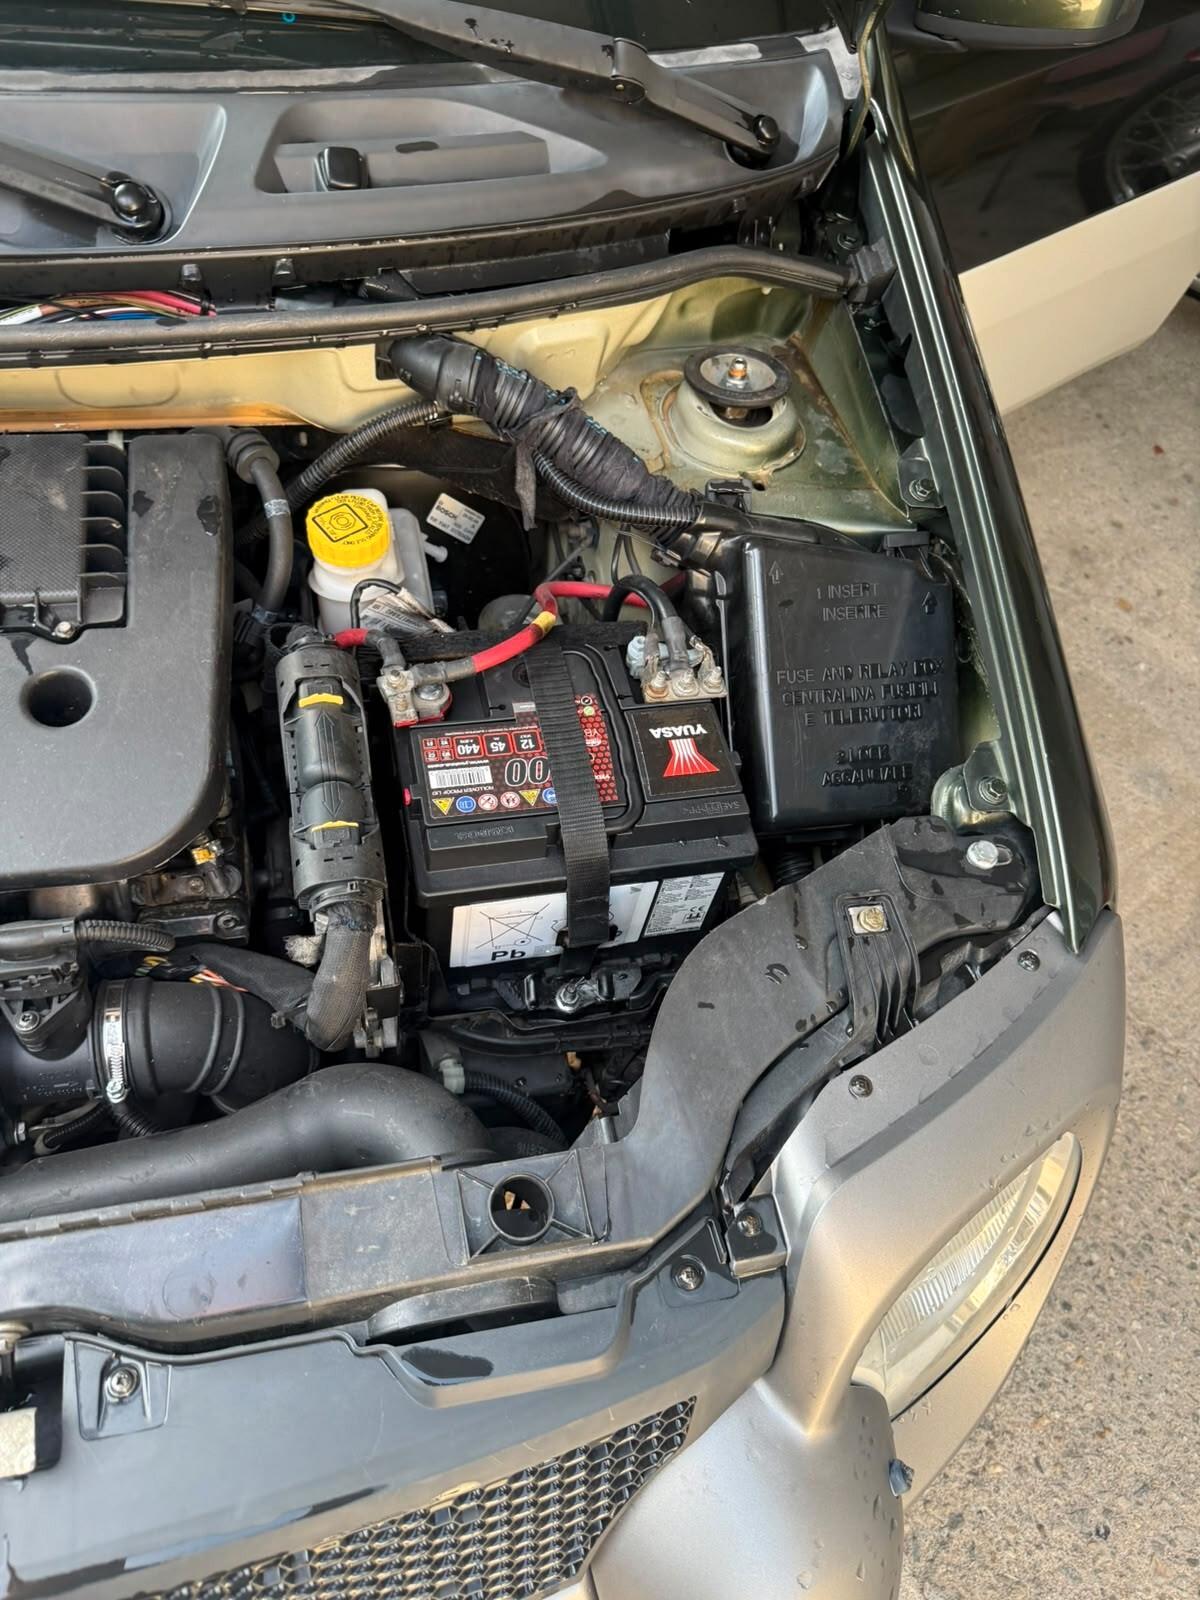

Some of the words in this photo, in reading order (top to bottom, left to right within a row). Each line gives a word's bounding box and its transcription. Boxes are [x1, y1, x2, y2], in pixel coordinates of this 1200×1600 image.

[435, 504, 460, 520] BOSCH
[827, 582, 880, 600] INSERT
[822, 603, 889, 622] INSERIRE
[776, 669, 815, 686] FUSE
[821, 665, 854, 682] AND
[858, 660, 908, 680] RELAY
[781, 685, 876, 706] CENTRALINA
[804, 711, 816, 727] E
[648, 722, 708, 739] YUASA
[457, 743, 480, 755] 440
[490, 741, 506, 752] 45
[520, 737, 535, 750] 12
[427, 758, 490, 769] www.yuasa.com
[431, 789, 442, 797] LID
[463, 784, 494, 793] ROLLOVER
[490, 948, 526, 962] Pb
